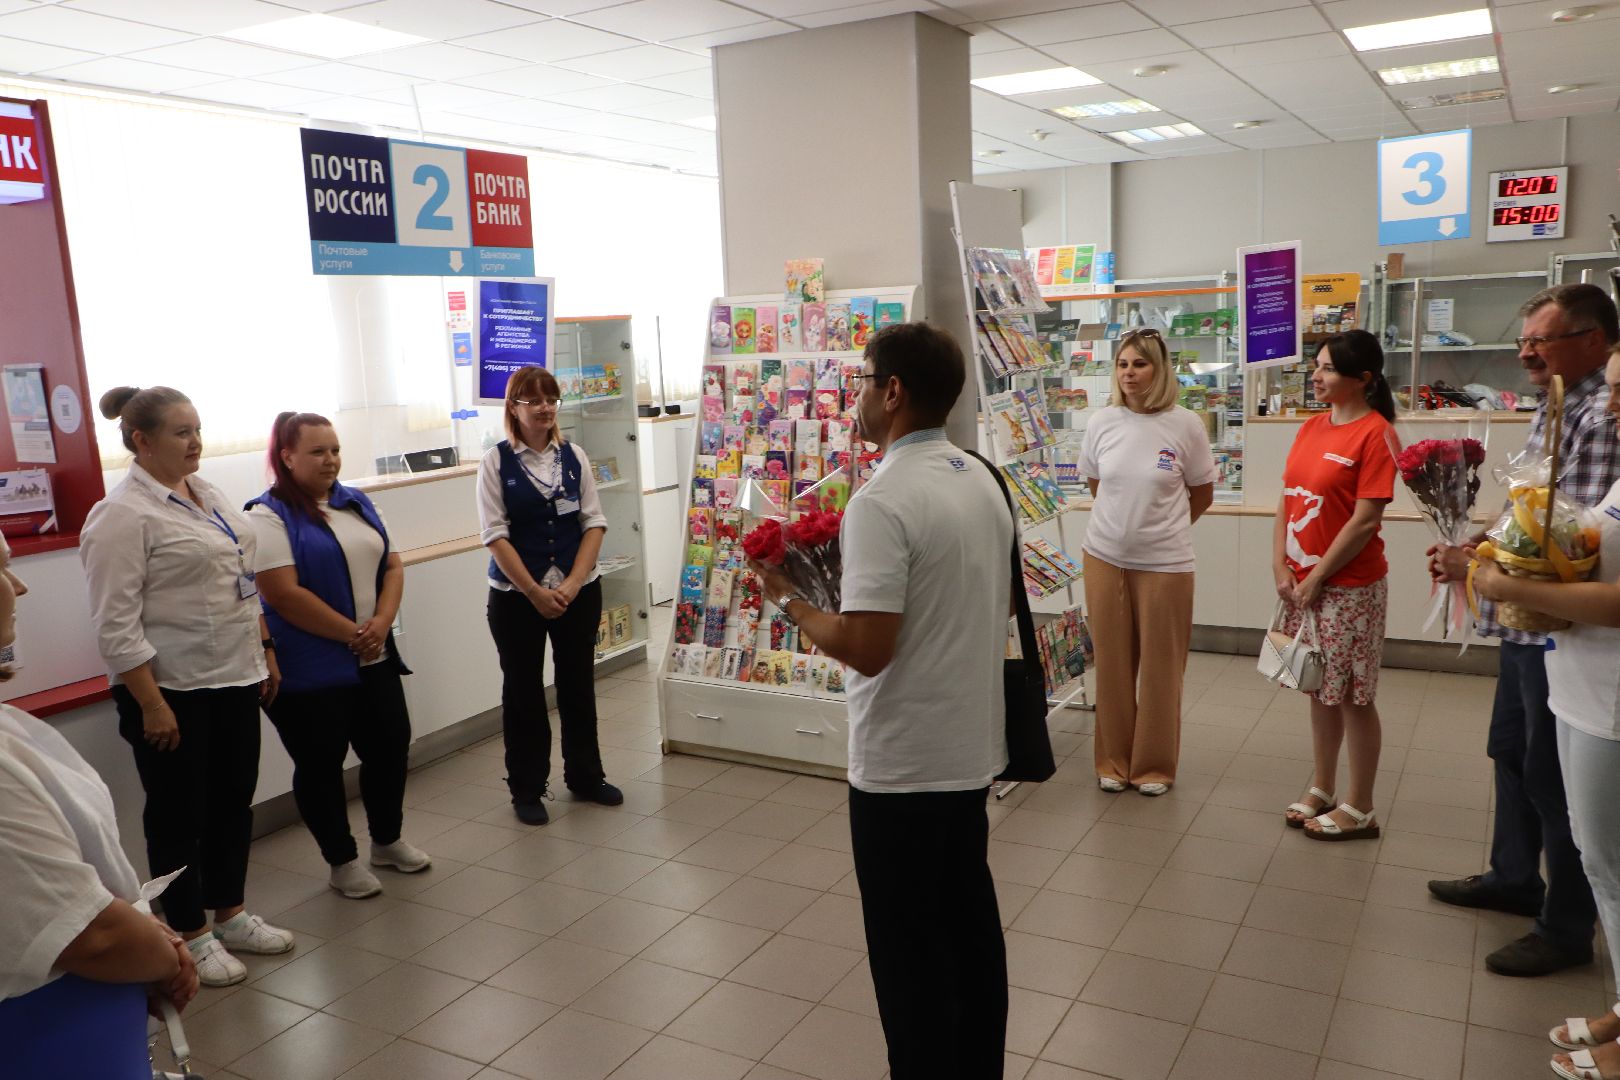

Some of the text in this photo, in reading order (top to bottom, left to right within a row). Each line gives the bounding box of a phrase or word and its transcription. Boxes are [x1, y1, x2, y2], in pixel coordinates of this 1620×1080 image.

[310, 153, 385, 184] ПОЧТА
[1401, 151, 1446, 206] 3
[473, 172, 526, 199] ПОЧТА
[313, 188, 388, 217] РОССИИ
[412, 164, 453, 231] 2
[476, 201, 522, 226] БАНК
[1501, 204, 1560, 224] 15:00
[318, 243, 369, 257] Почтовые
[480, 249, 521, 260] Банковские
[319, 260, 353, 271] услуги
[480, 263, 505, 273] услуги
[488, 314, 545, 322] СОТРУДНИЧЕСТВУ
